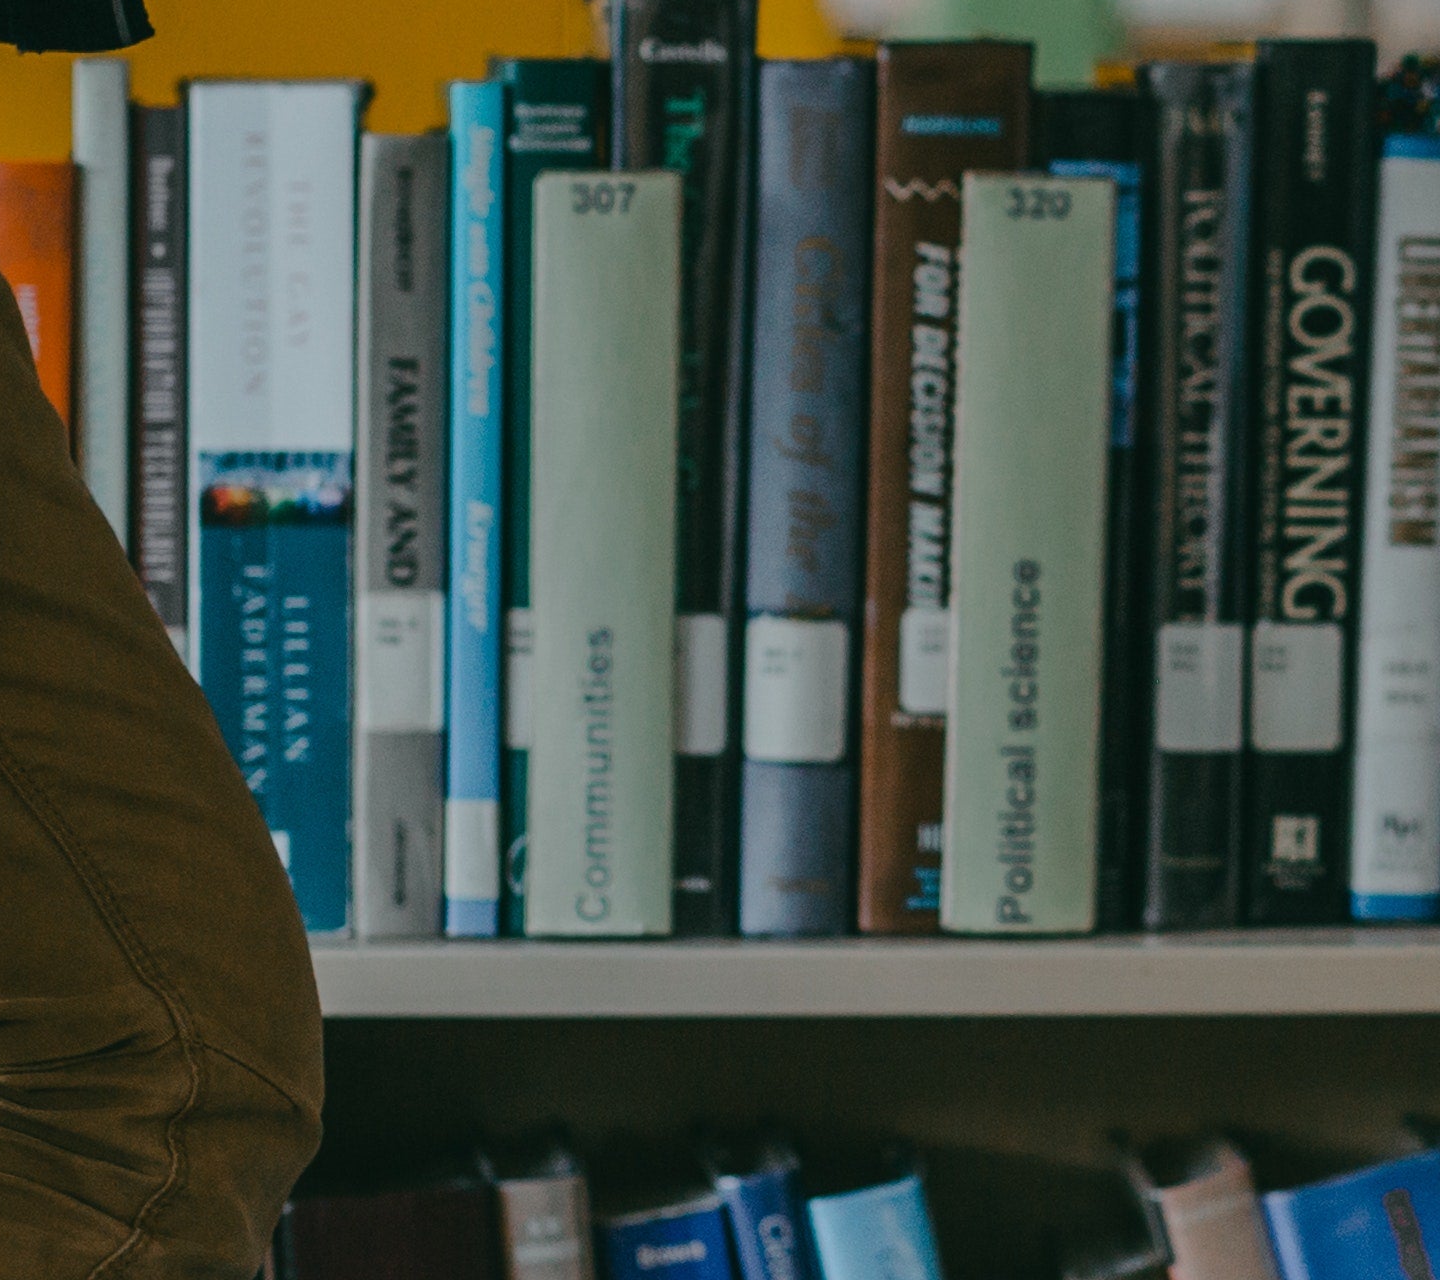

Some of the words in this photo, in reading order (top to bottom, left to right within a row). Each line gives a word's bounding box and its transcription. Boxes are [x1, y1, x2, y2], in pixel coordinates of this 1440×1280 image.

[571, 182, 636, 215] 307
[912, 241, 950, 314] FOR
[385, 355, 420, 489] FAMILY
[909, 322, 948, 496] DECISION
[1281, 245, 1356, 620] GOVERNING
[385, 496, 420, 588] AND
[282, 594, 311, 763] LILLIAN
[1001, 560, 1040, 731] science
[575, 628, 613, 922] Communities
[997, 746, 1039, 922] Political
